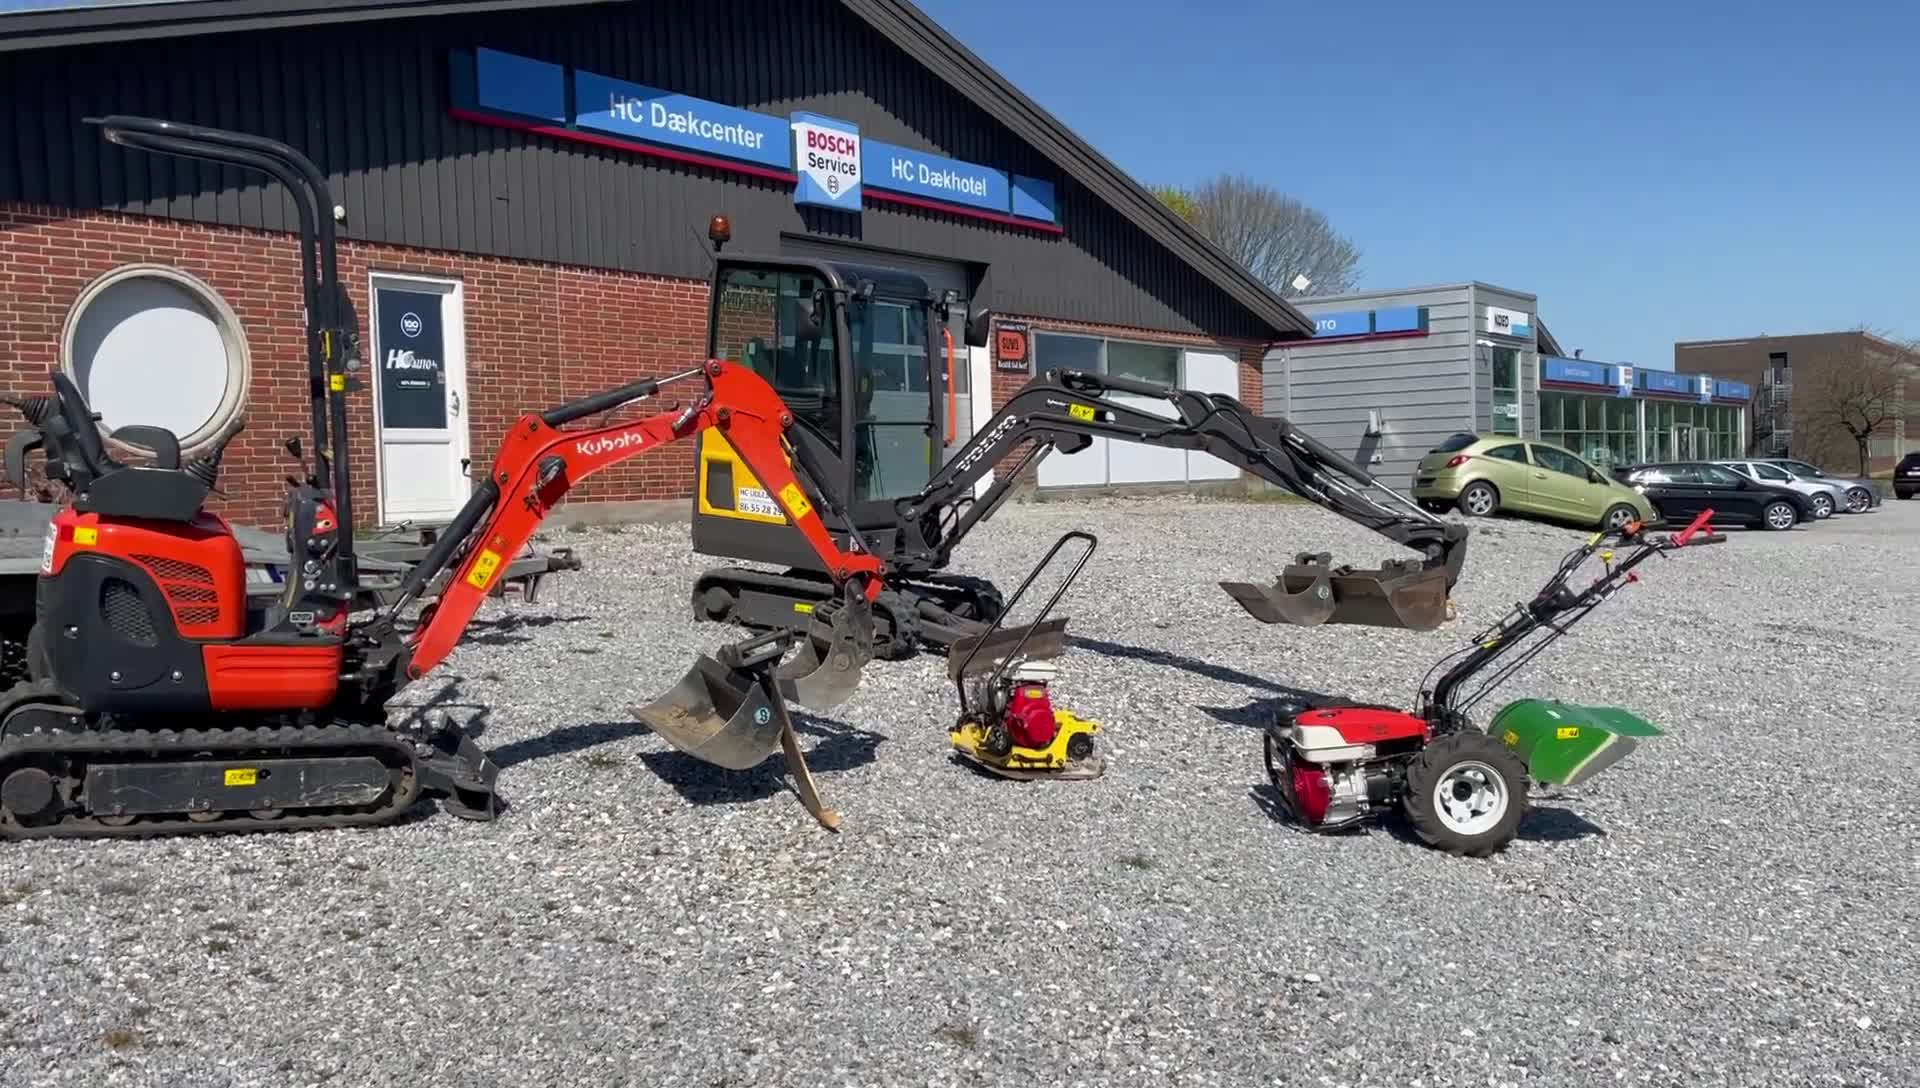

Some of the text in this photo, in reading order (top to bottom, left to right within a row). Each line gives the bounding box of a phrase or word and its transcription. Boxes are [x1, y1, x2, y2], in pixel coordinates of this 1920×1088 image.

[610, 92, 764, 149] HC Dækcenter
[807, 130, 855, 157] BOSCH
[808, 152, 856, 176] Service
[891, 157, 987, 197] HC Dækhotel
[576, 431, 643, 456] Kubota
[739, 502, 750, 512] 86
[751, 503, 761, 513] 55
[762, 504, 772, 515] 28
